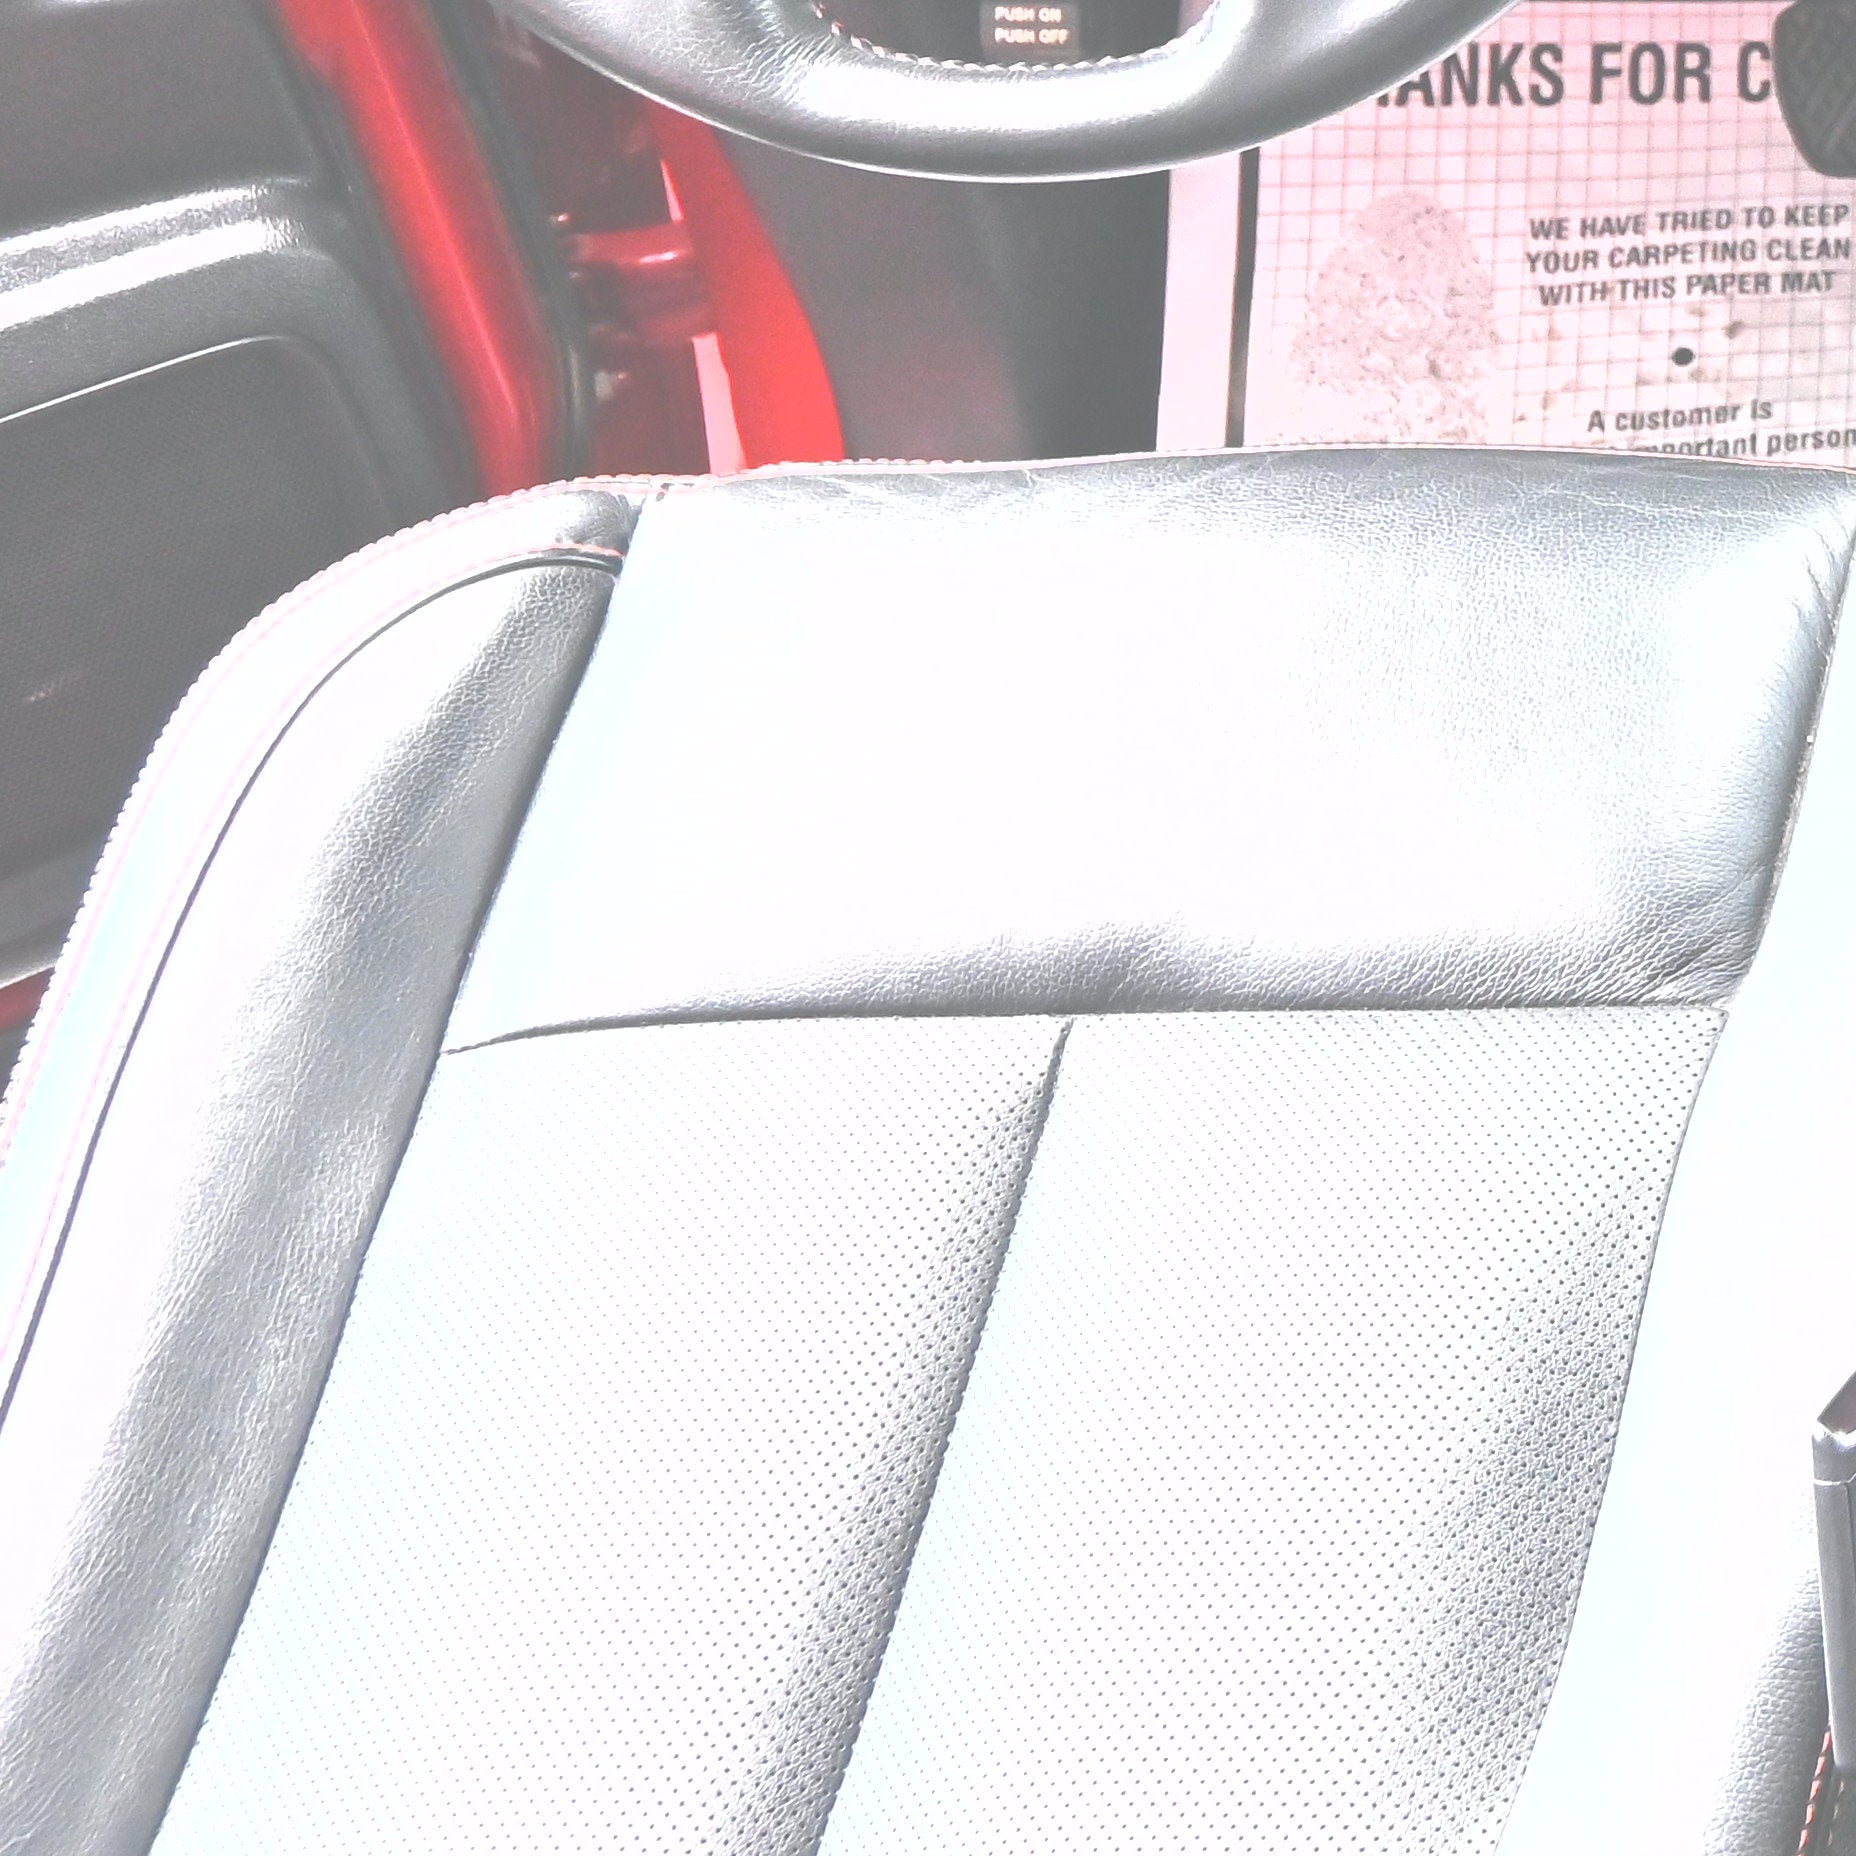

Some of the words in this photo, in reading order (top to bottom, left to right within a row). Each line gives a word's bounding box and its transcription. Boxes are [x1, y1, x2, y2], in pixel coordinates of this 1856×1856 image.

[1038, 7, 1062, 23] ON
[1038, 28, 1069, 45] OFF
[1377, 40, 1565, 107] ANKS
[1589, 40, 1713, 105] FOR
[1529, 216, 1571, 241] WE
[1579, 212, 1647, 239] HAVE
[1658, 208, 1733, 232] TRIED
[1741, 205, 1776, 229] TO
[1784, 203, 1850, 227] KEEP
[1525, 248, 1600, 275] YOUR
[1607, 239, 1758, 269] CARPETING
[1766, 236, 1851, 262] CLEAN
[1538, 278, 1609, 307] WITH
[1619, 275, 1676, 301] THIS
[1686, 271, 1772, 297] PAPER
[1780, 269, 1838, 295] MAT
[1587, 409, 1606, 433] A
[1614, 402, 1742, 432] customer
